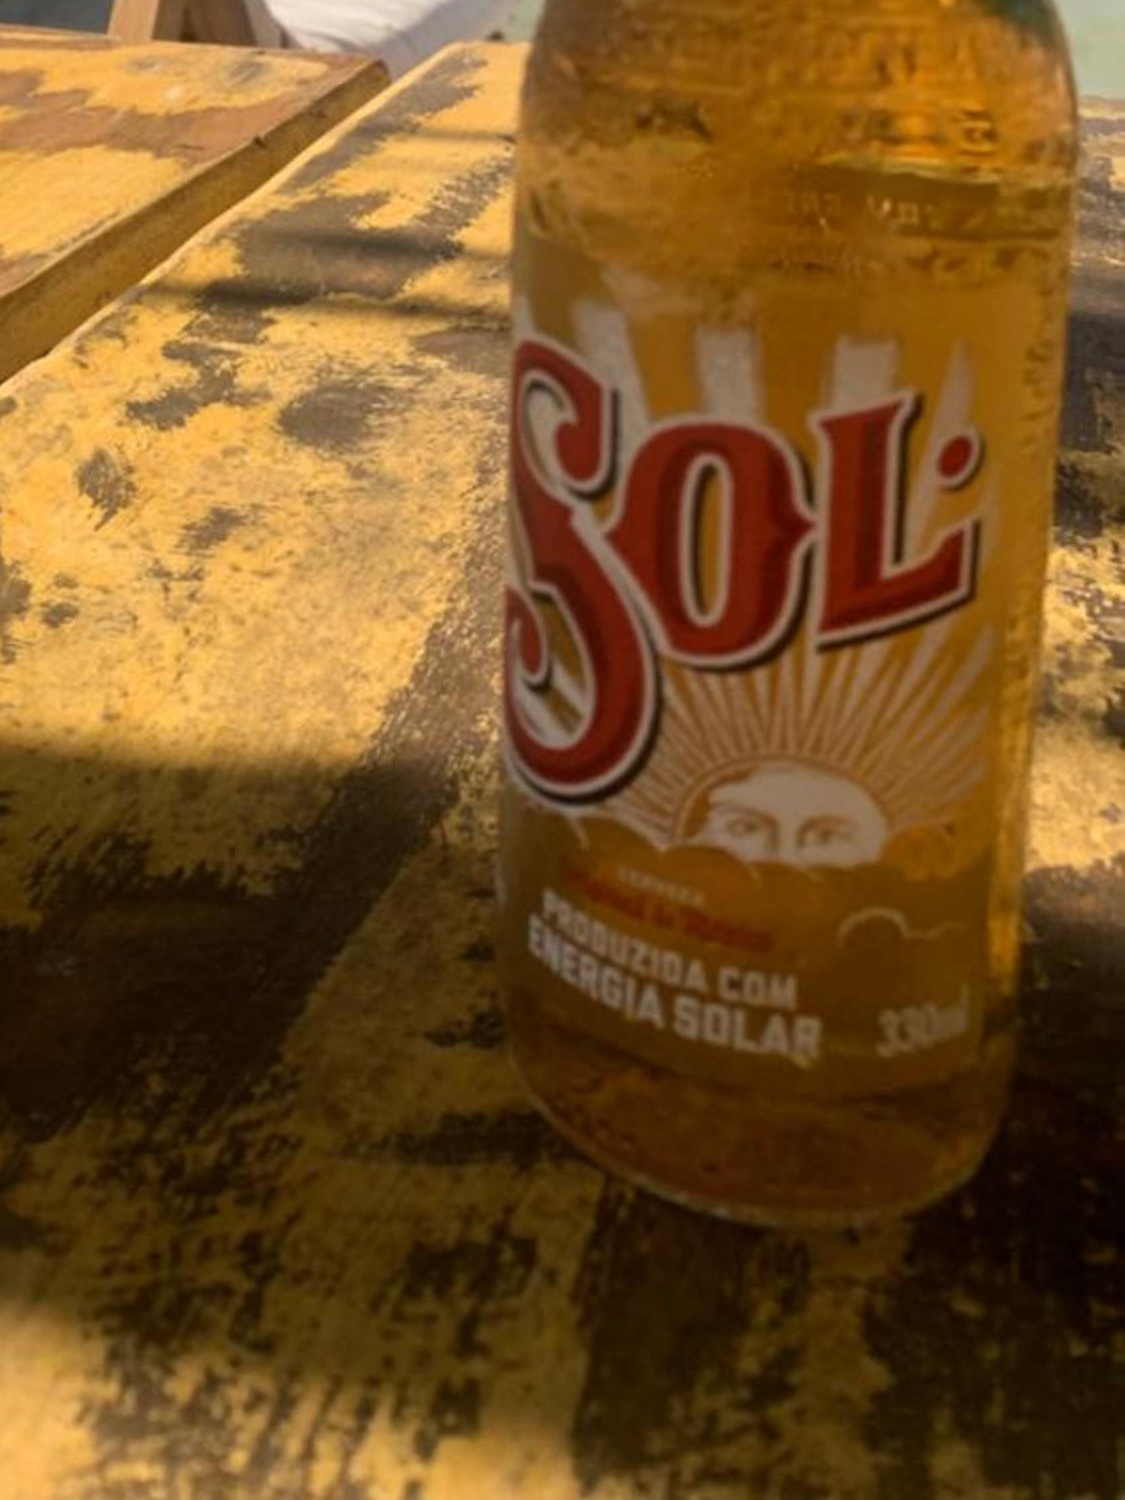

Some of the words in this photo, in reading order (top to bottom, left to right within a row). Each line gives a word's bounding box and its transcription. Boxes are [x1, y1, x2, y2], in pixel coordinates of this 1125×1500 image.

[505, 336, 981, 804] SOL
[527, 912, 666, 1030] ENERGIA
[673, 994, 823, 1060] SOLAR
[542, 887, 709, 994] PRODUZIDA
[718, 965, 798, 1012] COM
